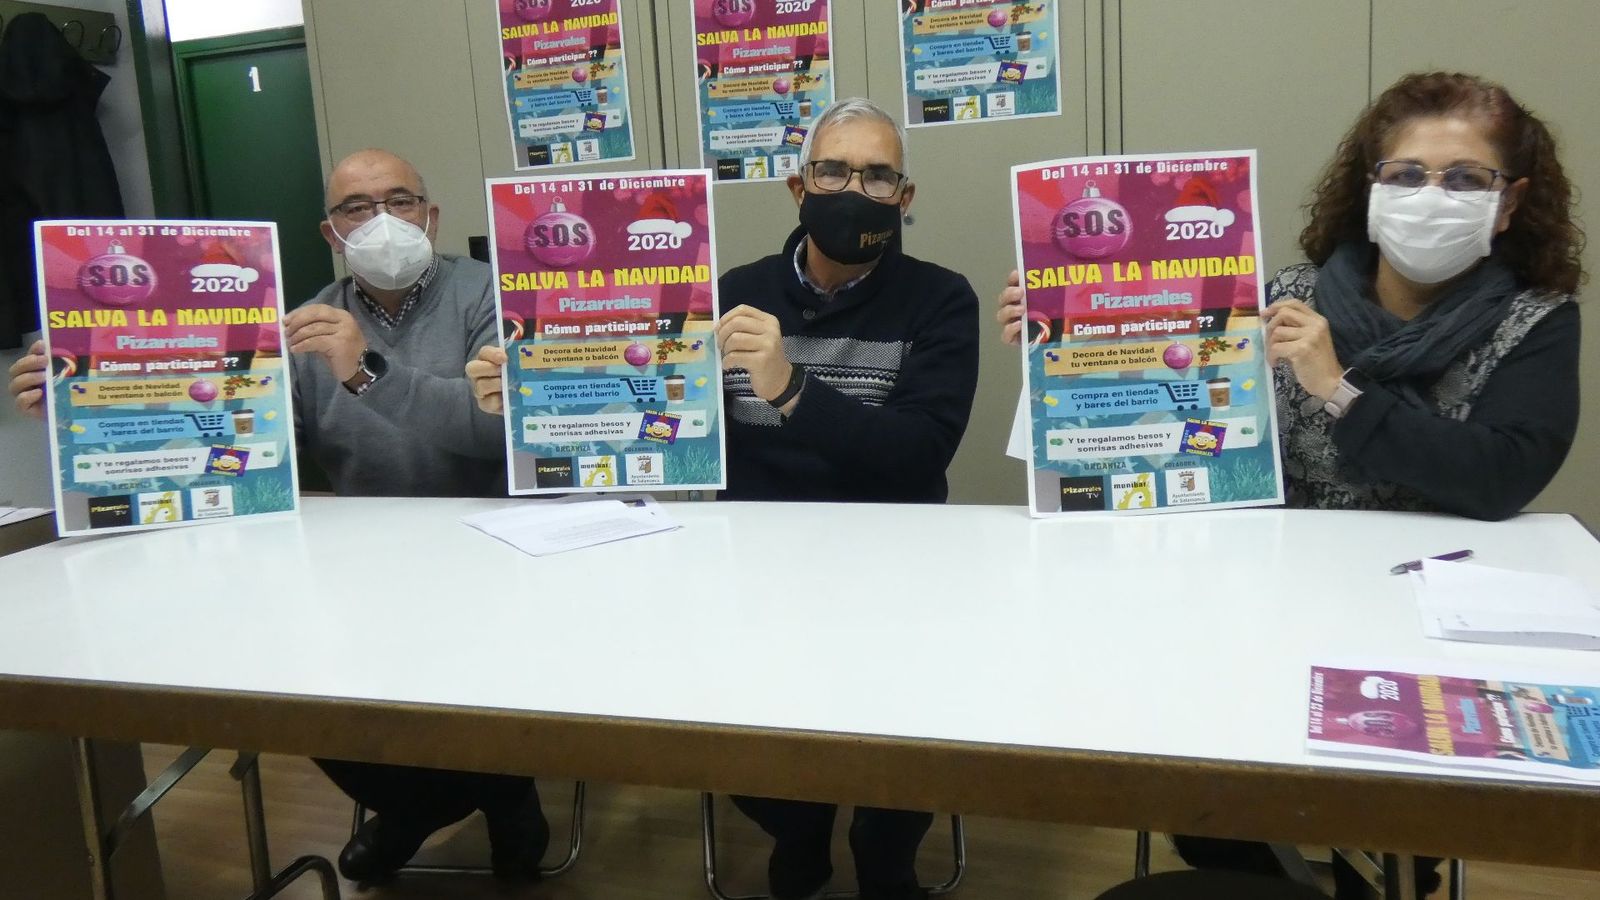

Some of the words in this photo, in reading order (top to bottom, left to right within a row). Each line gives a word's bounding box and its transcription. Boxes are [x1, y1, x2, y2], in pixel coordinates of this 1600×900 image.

[776, 1, 810, 14] 2020
[502, 24, 538, 40] SALVA
[544, 21, 559, 33] LA
[564, 12, 617, 31] NAVIDAD
[698, 30, 738, 46] SALVA
[745, 28, 761, 41] LA
[767, 22, 827, 39] NAVIDAD
[549, 53, 586, 64] participar
[588, 50, 597, 58] ??
[733, 45, 791, 58] Pizarrales
[749, 64, 790, 73] participar
[249, 67, 261, 92] 1
[1042, 168, 1064, 180] Del
[1072, 166, 1089, 177] 14
[1096, 165, 1108, 175] al
[1114, 163, 1129, 174] 31
[1136, 163, 1152, 174] de
[1157, 161, 1228, 173] Diciembre
[515, 184, 534, 195] Del
[541, 183, 556, 193] 14
[561, 182, 572, 192] al
[578, 181, 593, 191] 31
[600, 179, 614, 190] de
[620, 178, 685, 189] Diciembre
[67, 227, 92, 236] Del
[97, 227, 113, 235] 14
[139, 227, 154, 235] 31
[161, 227, 177, 235] de
[183, 227, 251, 237] Diciembre
[1166, 223, 1224, 240] 2020
[628, 235, 682, 251] 2020
[501, 271, 568, 292] SALVA
[578, 269, 604, 287] LA
[614, 265, 709, 285] NAVIDAD
[1027, 264, 1103, 289] SALVA
[1113, 261, 1142, 282] LA
[1152, 255, 1255, 280] NAVIDAD
[192, 278, 248, 292] 2020
[559, 295, 651, 312] Pizarrales
[1091, 290, 1193, 309] Pizarrales
[50, 311, 127, 328] SALVA
[139, 310, 167, 326] LA
[177, 307, 277, 325] NAVIDAD
[545, 323, 580, 335] Cómo
[585, 320, 650, 334] participar
[656, 319, 671, 331] ??
[1074, 323, 1116, 336] Cómo
[1121, 319, 1191, 333] participar
[1197, 316, 1213, 328] ??
[117, 336, 218, 349] Pizarrales
[1120, 347, 1154, 355] Navidad
[101, 360, 140, 371] Cómo
[146, 359, 216, 371] participar
[222, 357, 239, 367] ??
[1128, 355, 1157, 363] balcón
[544, 384, 575, 392] Compra
[1072, 391, 1109, 401] Compra
[1126, 388, 1159, 396] tiendas
[548, 392, 553, 400] y
[1076, 403, 1082, 411] y
[1084, 401, 1111, 409] bares
[1114, 399, 1129, 407] del
[1131, 397, 1158, 405] barrio
[559, 422, 598, 430] regalamos
[1078, 445, 1117, 453] sonrisas
[1120, 441, 1163, 450] adhesivas
[1088, 435, 1135, 445] regalamos
[1084, 462, 1126, 470] ORGANIZA
